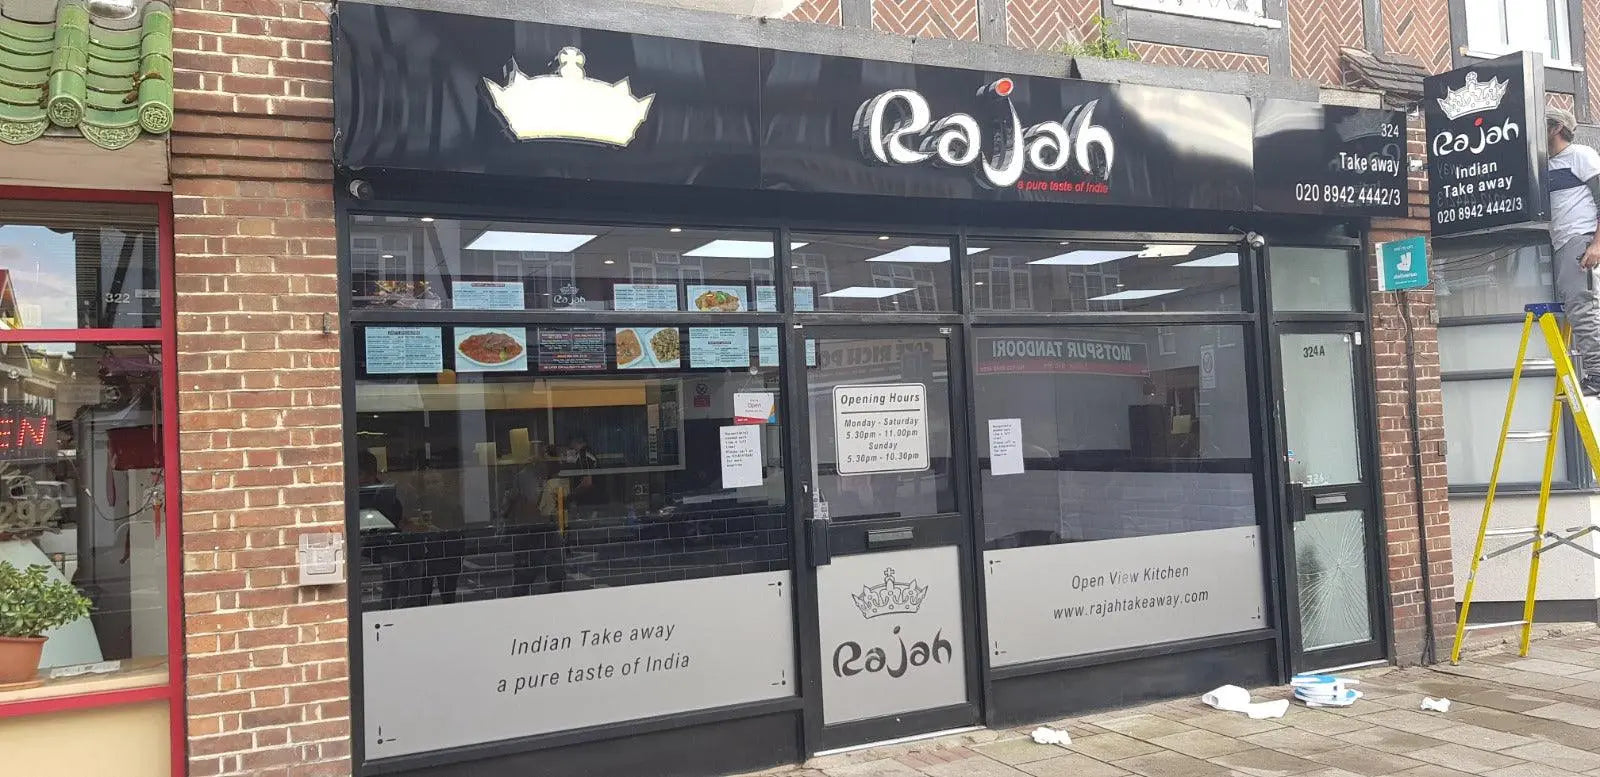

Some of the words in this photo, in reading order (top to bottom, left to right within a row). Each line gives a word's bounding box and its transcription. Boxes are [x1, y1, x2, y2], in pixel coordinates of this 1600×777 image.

[865, 77, 1115, 187] Rajah
[1380, 123, 1400, 138] 324
[1433, 116, 1520, 156] Rajah
[1339, 151, 1368, 171] Take
[1371, 158, 1401, 177] away
[1455, 161, 1498, 180] Indian
[1017, 181, 1025, 190] a
[1026, 181, 1048, 192] pure
[1049, 180, 1073, 192] taste
[1074, 181, 1084, 192] of
[1085, 182, 1109, 195] India
[1295, 182, 1320, 202] 020
[1323, 184, 1355, 204] 8942
[1358, 186, 1401, 206] 4442/3
[1443, 182, 1474, 199] Take
[1478, 175, 1513, 193] away
[1437, 208, 1456, 224] 020
[1458, 203, 1484, 221] 8942
[1486, 196, 1523, 216] 4442/3
[105, 292, 130, 304] 322
[553, 293, 586, 306] Rajah
[1302, 345, 1326, 359] 324A
[840, 393, 886, 407] Opening
[889, 392, 920, 403] Hours
[844, 419, 876, 429] Monday
[883, 417, 919, 427] Saturday
[846, 430, 876, 440] 5.30pm
[884, 428, 918, 438] 11.00pm
[868, 441, 898, 450] Sunday
[847, 454, 878, 463] 5.30pm
[885, 451, 919, 462] 10.30pm
[1071, 574, 1105, 591] Open
[1109, 570, 1140, 586] View
[1143, 564, 1190, 582] Kitchen
[1053, 589, 1209, 620] www.rajahtakeaway.com
[510, 634, 572, 656] Indian
[580, 627, 623, 648] Take
[629, 623, 676, 642] away
[832, 625, 954, 679] Rajah
[497, 678, 507, 693] a
[514, 671, 560, 695] pure
[567, 663, 615, 684] taste
[621, 656, 641, 676] of
[646, 652, 690, 673] India
